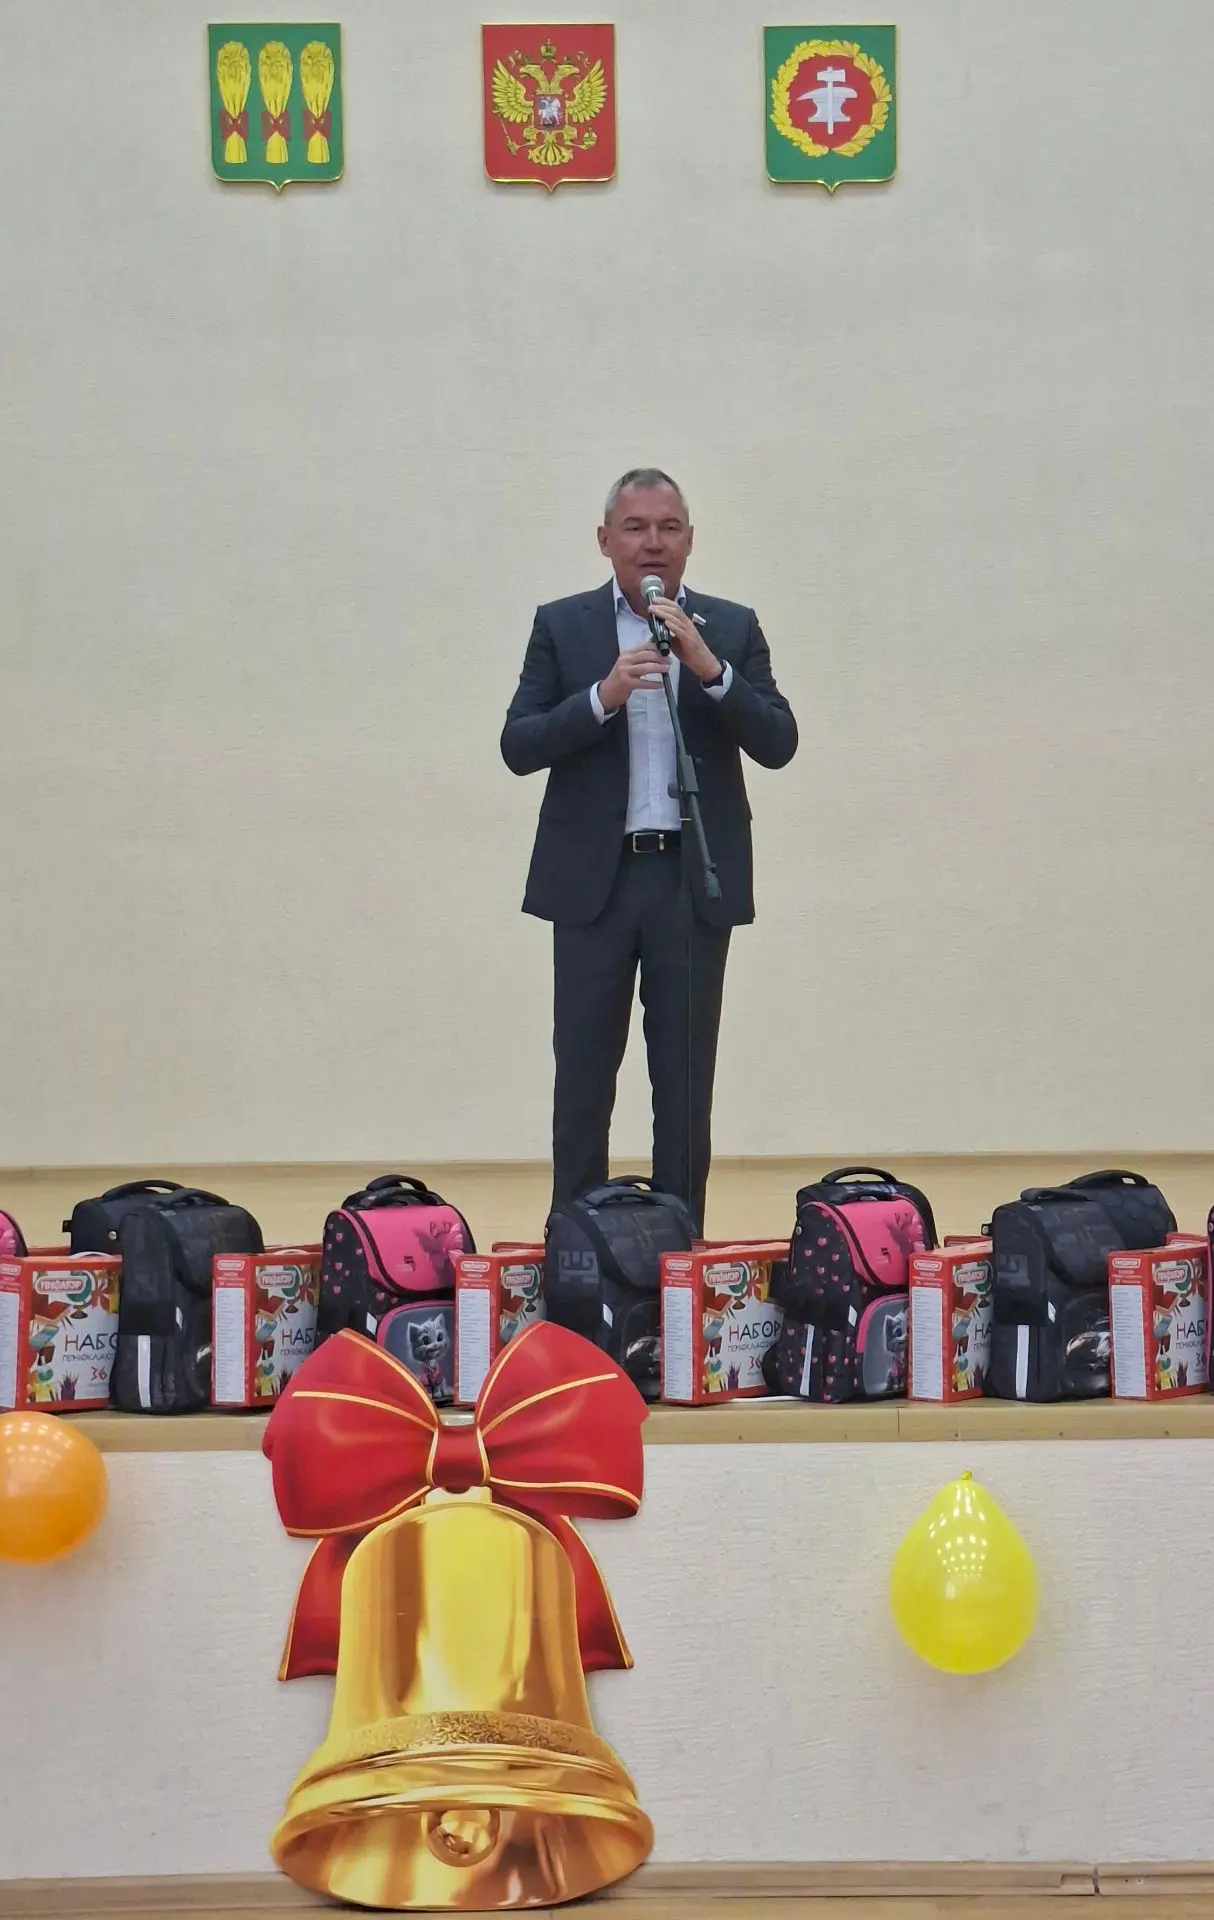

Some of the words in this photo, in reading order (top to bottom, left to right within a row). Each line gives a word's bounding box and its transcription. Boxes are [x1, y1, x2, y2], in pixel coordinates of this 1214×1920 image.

[281, 1327, 314, 1346] НАБ
[729, 1320, 781, 1342] НАБОР
[1176, 1319, 1204, 1340] НАБ
[64, 1333, 118, 1352] НАБО
[91, 1366, 108, 1380] 36
